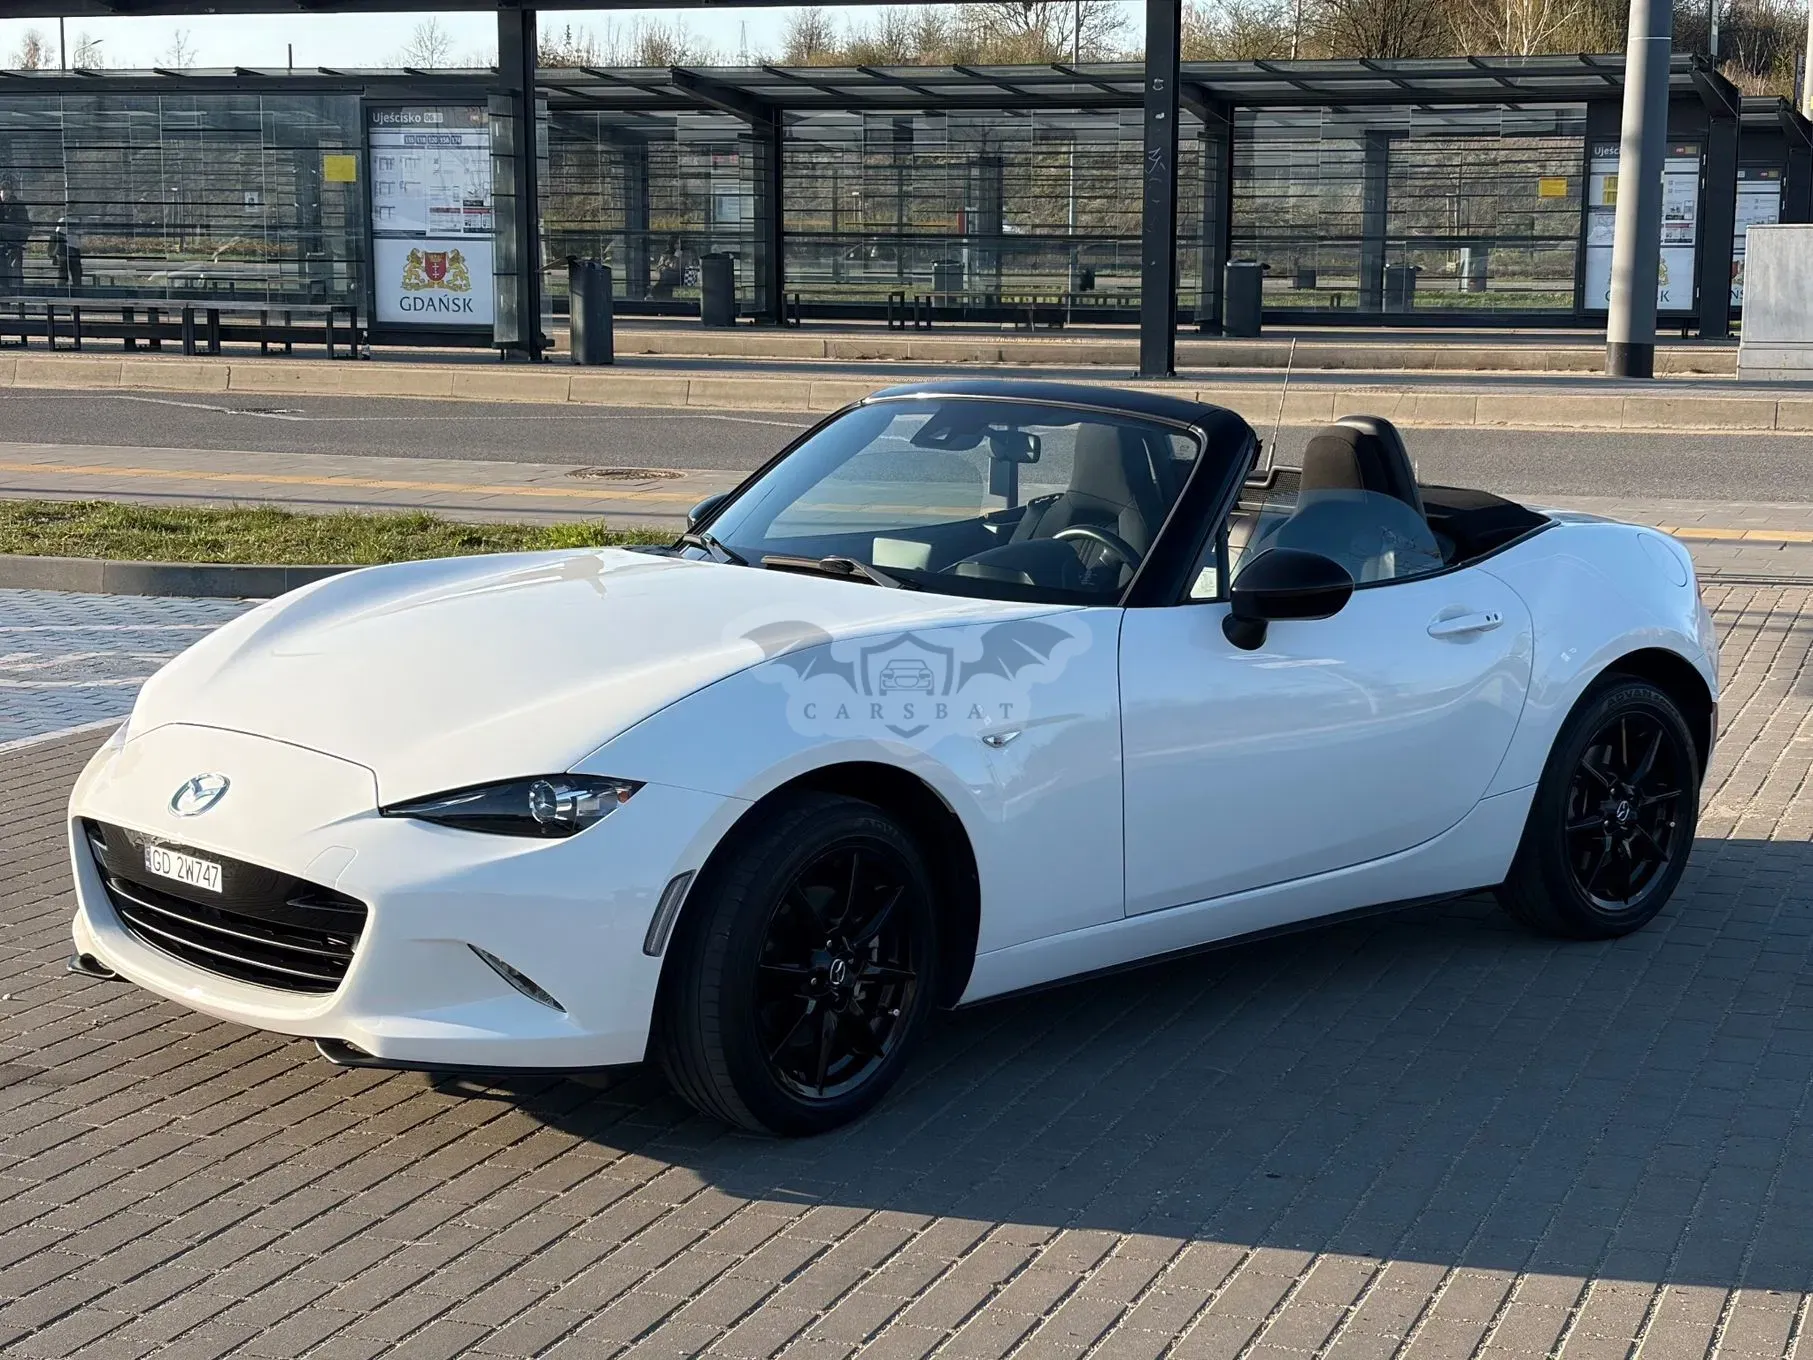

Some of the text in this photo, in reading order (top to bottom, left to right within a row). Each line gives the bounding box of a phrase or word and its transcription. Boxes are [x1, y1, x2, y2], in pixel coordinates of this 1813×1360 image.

[372, 112, 422, 125] Ujeścisko
[400, 294, 473, 313] GDAŃSK
[153, 849, 171, 875] GD
[176, 856, 219, 889] 2W747
